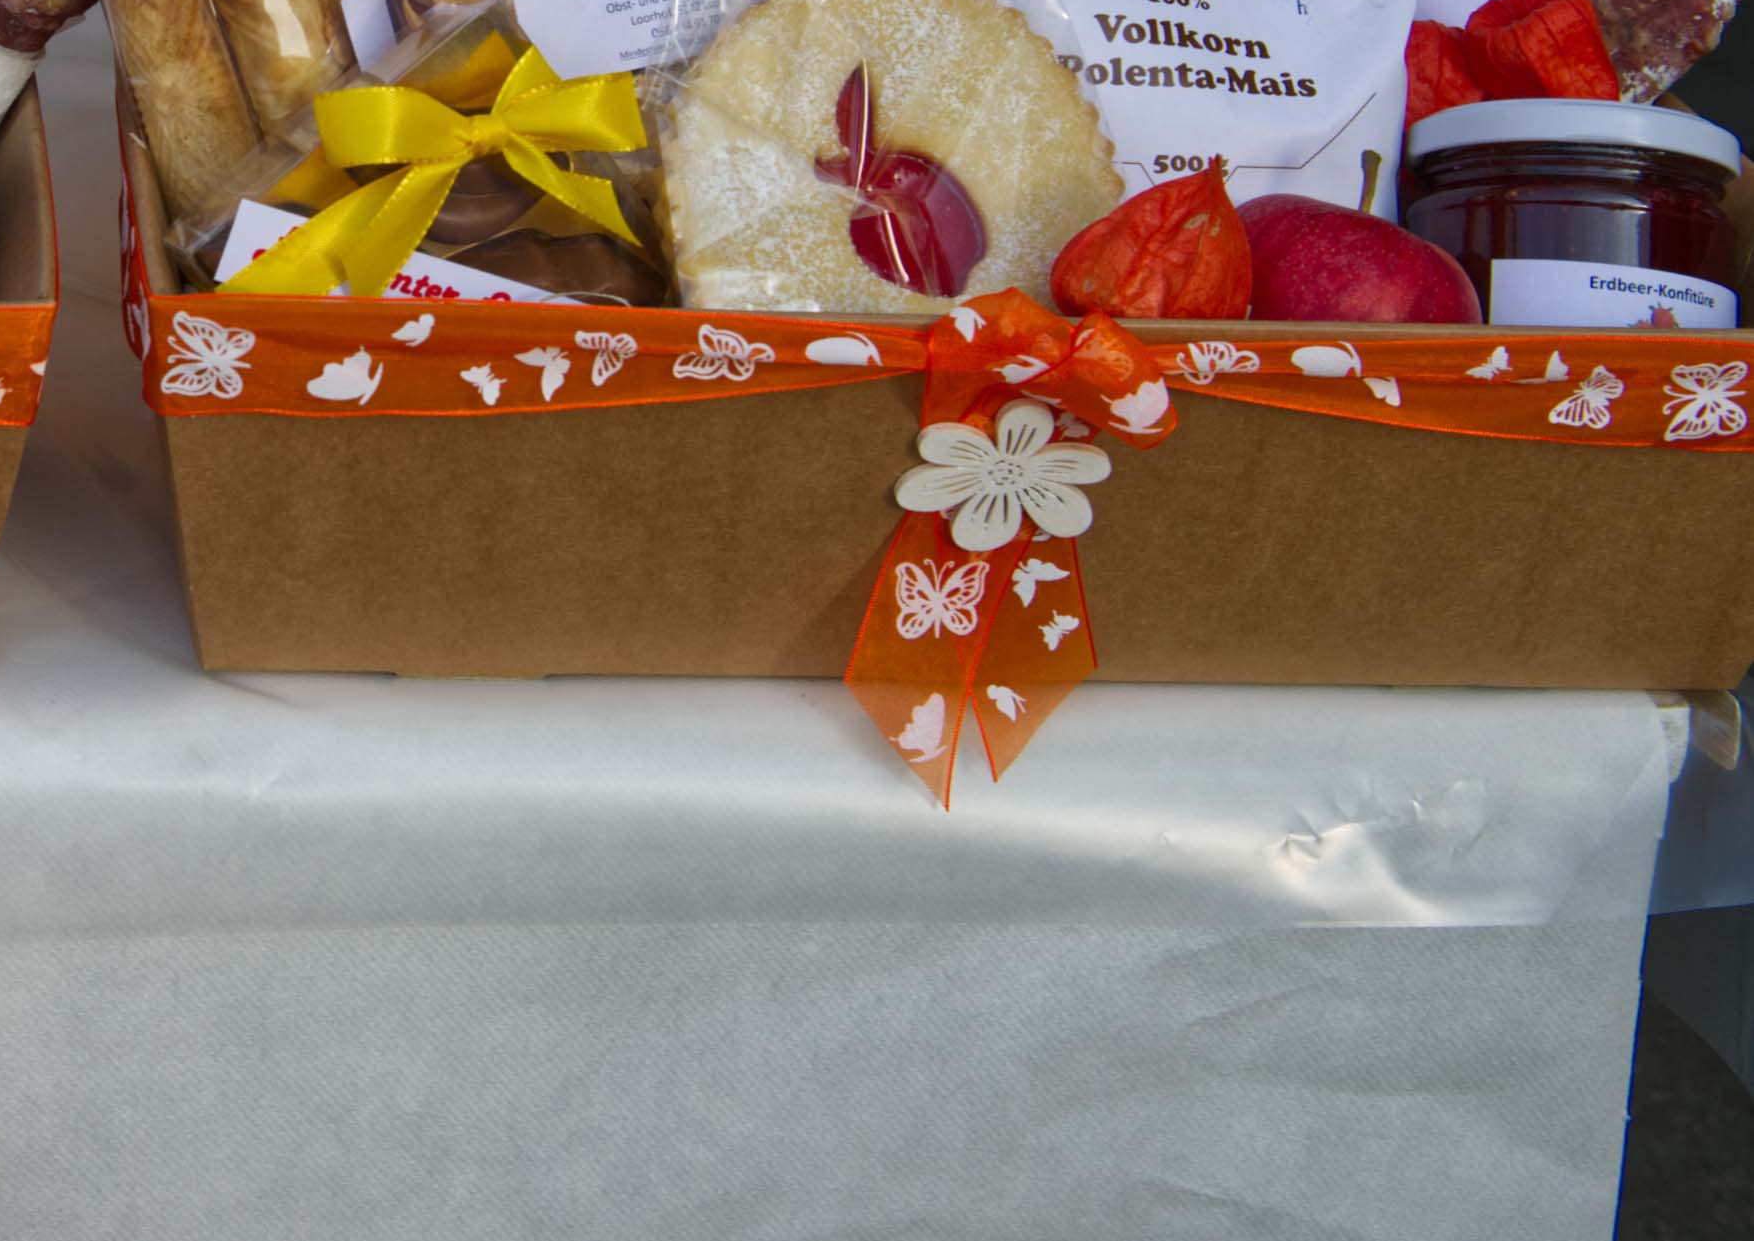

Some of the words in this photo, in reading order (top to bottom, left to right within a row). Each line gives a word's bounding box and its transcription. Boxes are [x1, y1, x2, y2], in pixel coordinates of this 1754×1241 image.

[1093, 13, 1271, 60] Vollkorn
[1152, 154, 1205, 175] 500
[1589, 275, 1716, 309] Erdbeer-Konfitüre
